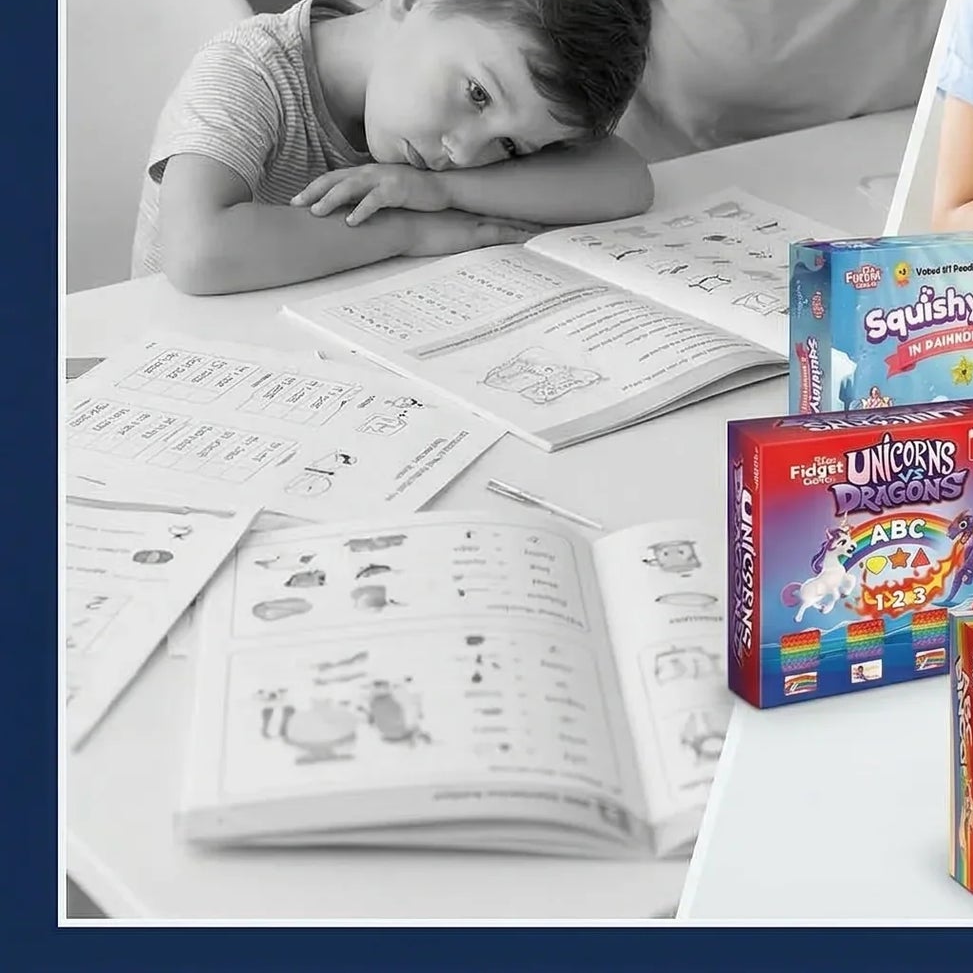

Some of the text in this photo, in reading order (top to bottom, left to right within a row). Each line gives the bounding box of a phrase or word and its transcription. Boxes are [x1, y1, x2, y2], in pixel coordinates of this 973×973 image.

[831, 471, 969, 517] DRAGONS
[871, 518, 926, 545] ABC
[876, 587, 926, 611] 1 2 3
